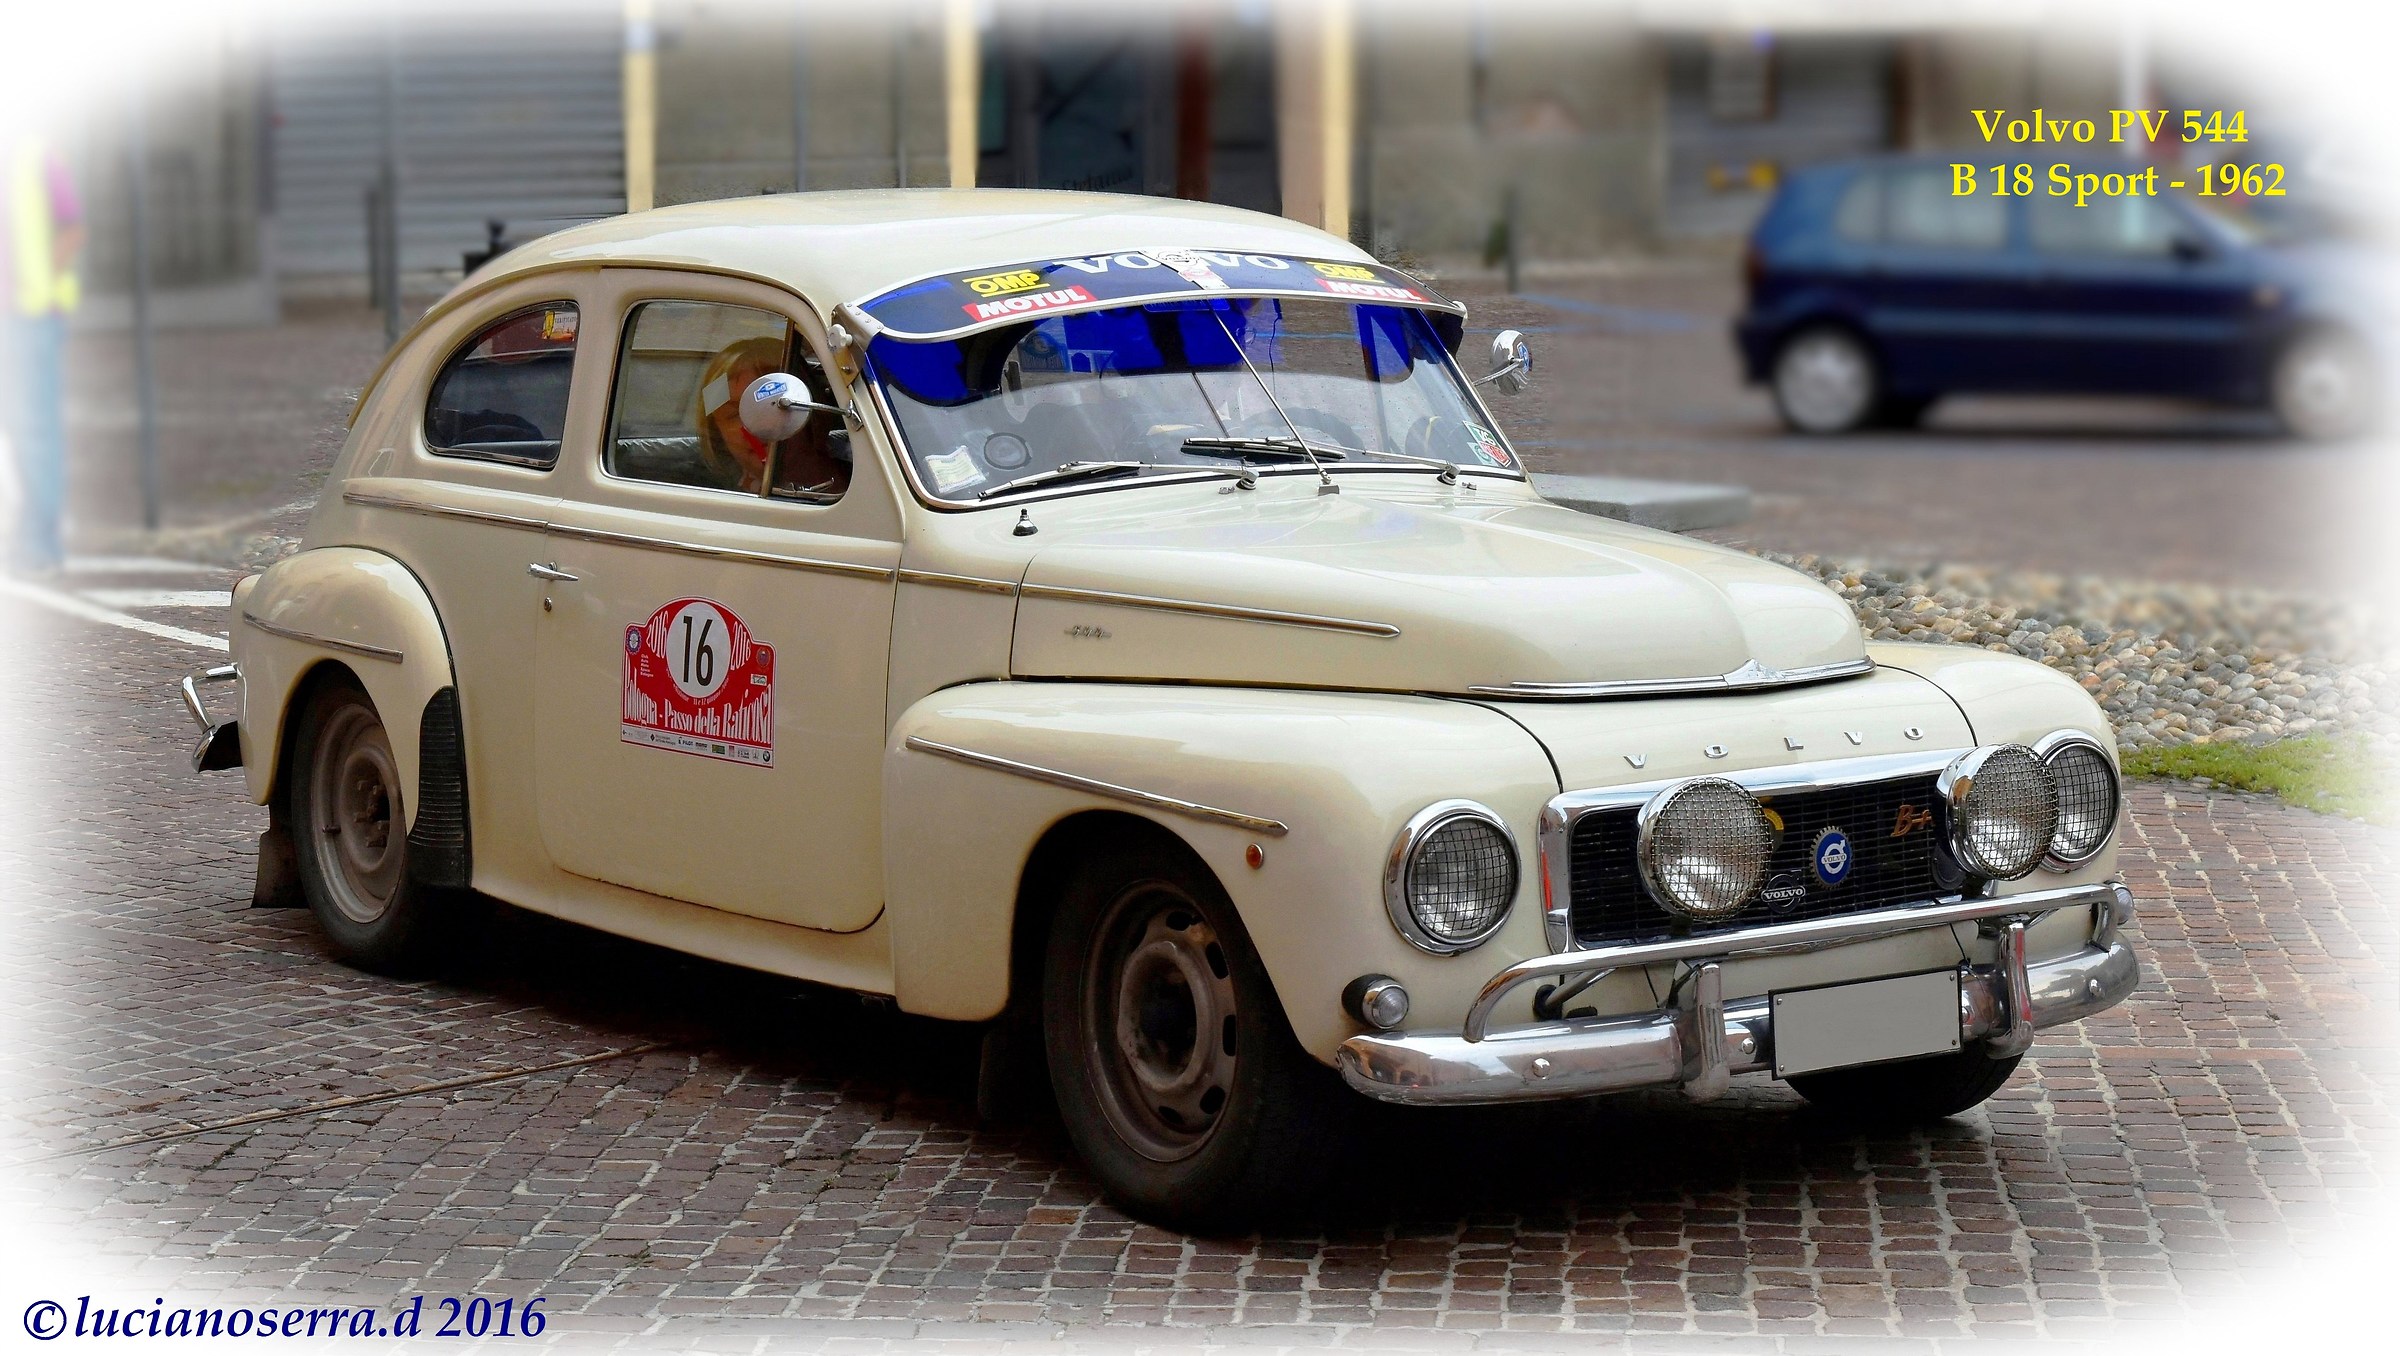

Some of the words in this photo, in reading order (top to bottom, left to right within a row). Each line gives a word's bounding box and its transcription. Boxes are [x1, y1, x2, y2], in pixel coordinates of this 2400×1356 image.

[1052, 253, 1290, 274] VOVO
[970, 272, 1040, 294] OMP
[1325, 280, 1422, 301] MOTUL
[976, 288, 1087, 318] MOTUL
[646, 610, 669, 659] 2016
[730, 621, 751, 671] 2016
[682, 615, 714, 686] 16
[624, 651, 658, 726] Bologna
[664, 698, 693, 733] Passo
[694, 707, 721, 737] della
[1623, 726, 1924, 769] VOLVO
[1822, 854, 1846, 864] VOLVO
[1763, 887, 1804, 900] VOLVO
